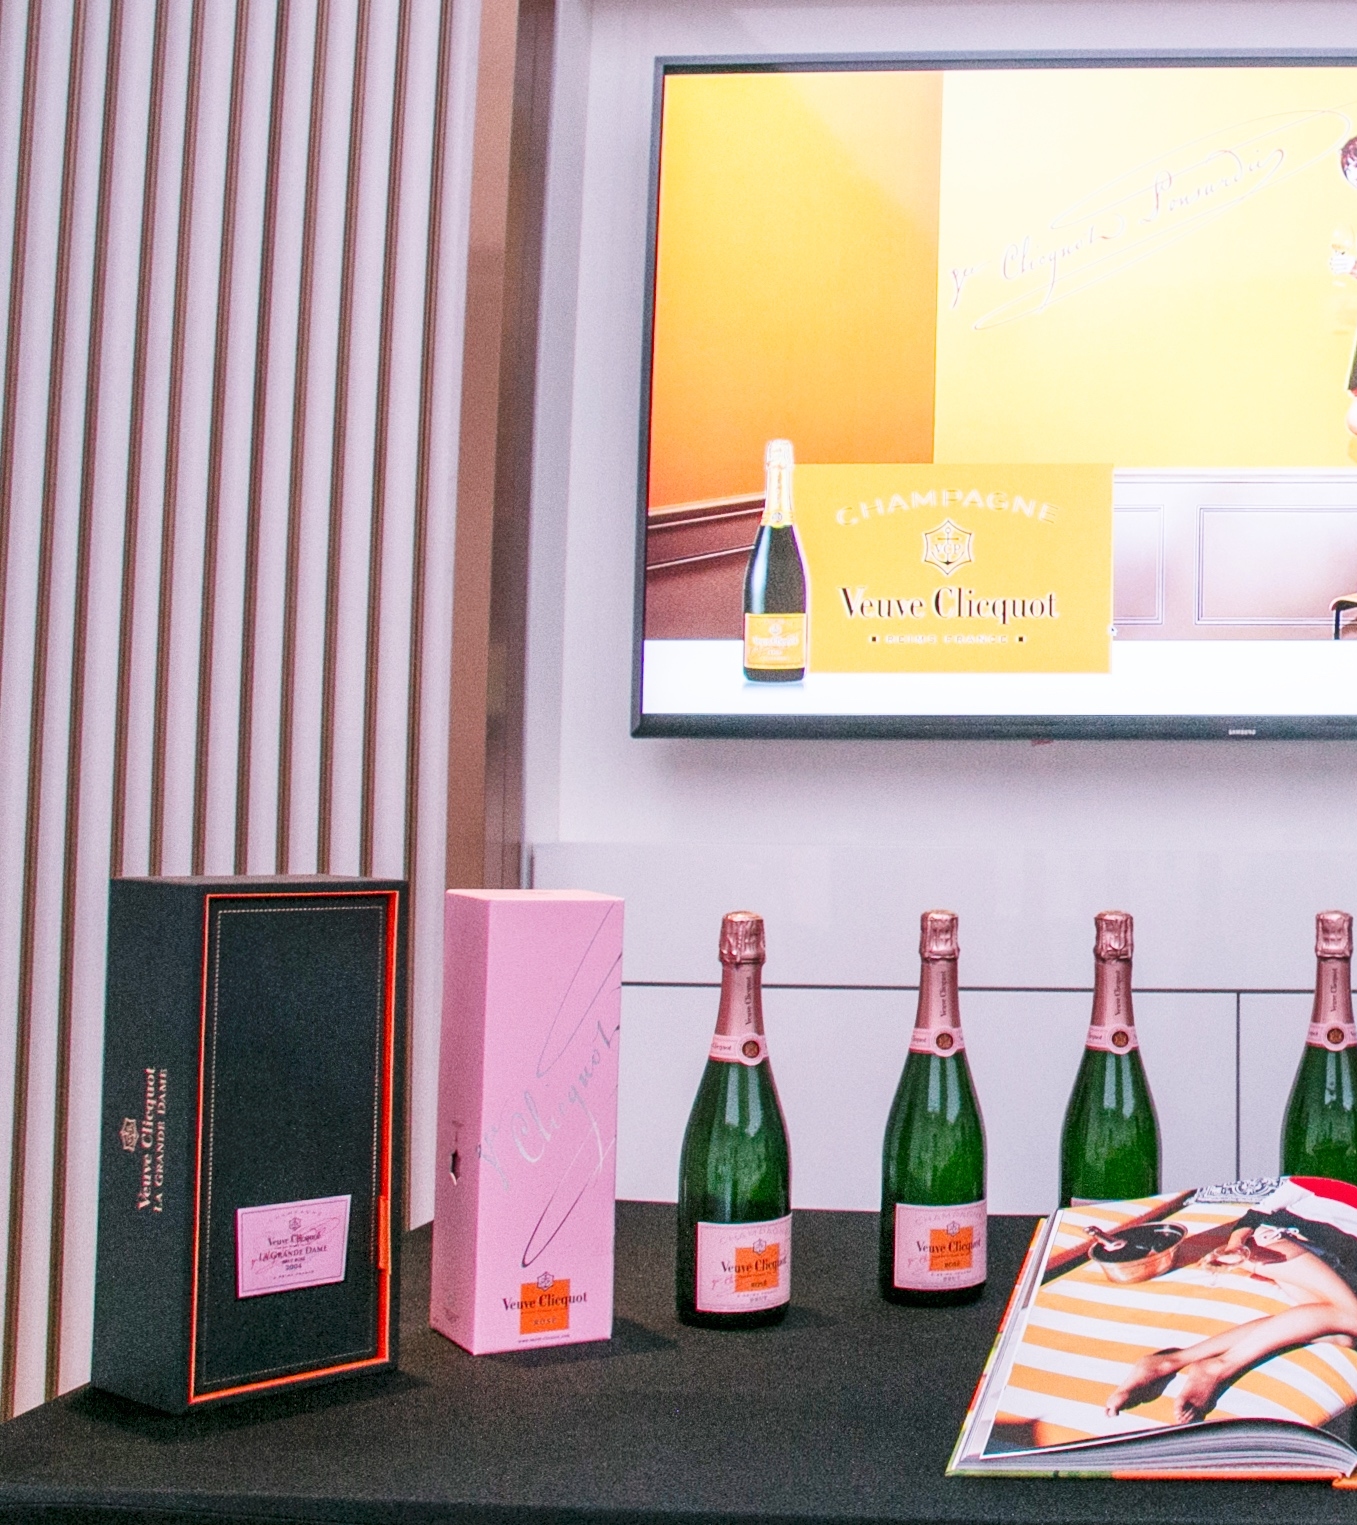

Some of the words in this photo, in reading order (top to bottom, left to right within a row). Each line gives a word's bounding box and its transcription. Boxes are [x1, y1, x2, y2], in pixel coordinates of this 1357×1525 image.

[836, 488, 1060, 525] CHAMPAGNE
[838, 585, 924, 618] Veuve
[933, 586, 1059, 625] Clicquot
[885, 634, 936, 645] REIMS
[944, 634, 1009, 645] FRANCE
[157, 1068, 167, 1115] DAME
[140, 1067, 156, 1149] Clicquot
[154, 1121, 166, 1187] GRANDE
[136, 1153, 152, 1210] Veuve
[153, 1193, 163, 1213] LA
[305, 1245, 328, 1254] DAME
[916, 1241, 946, 1253] Veuve
[721, 1261, 752, 1273] Veuve
[503, 1297, 535, 1311] Veuve
[538, 1292, 587, 1308] Clicquot
